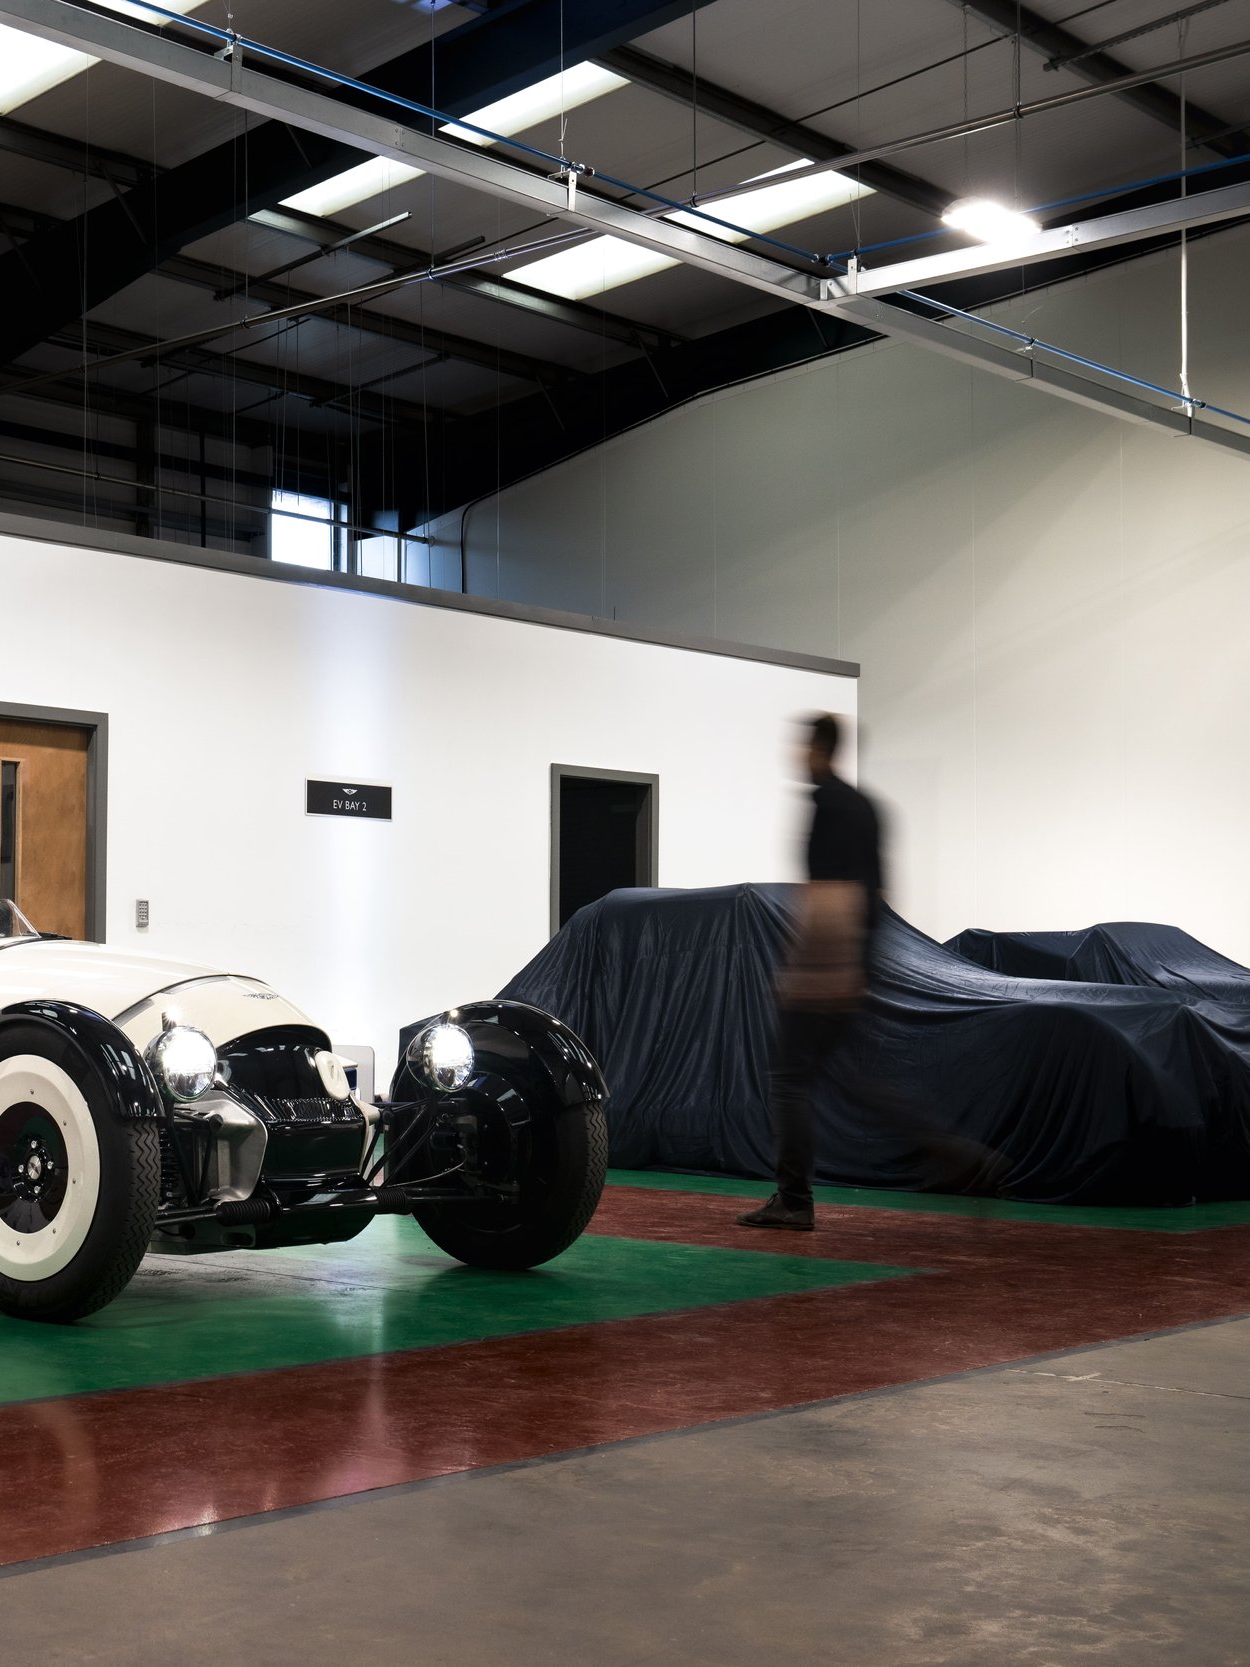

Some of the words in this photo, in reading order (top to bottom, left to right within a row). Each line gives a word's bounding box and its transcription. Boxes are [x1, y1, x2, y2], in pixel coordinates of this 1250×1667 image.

[333, 799, 343, 809] EV
[345, 800, 360, 810] BAY
[362, 802, 367, 811] 2
